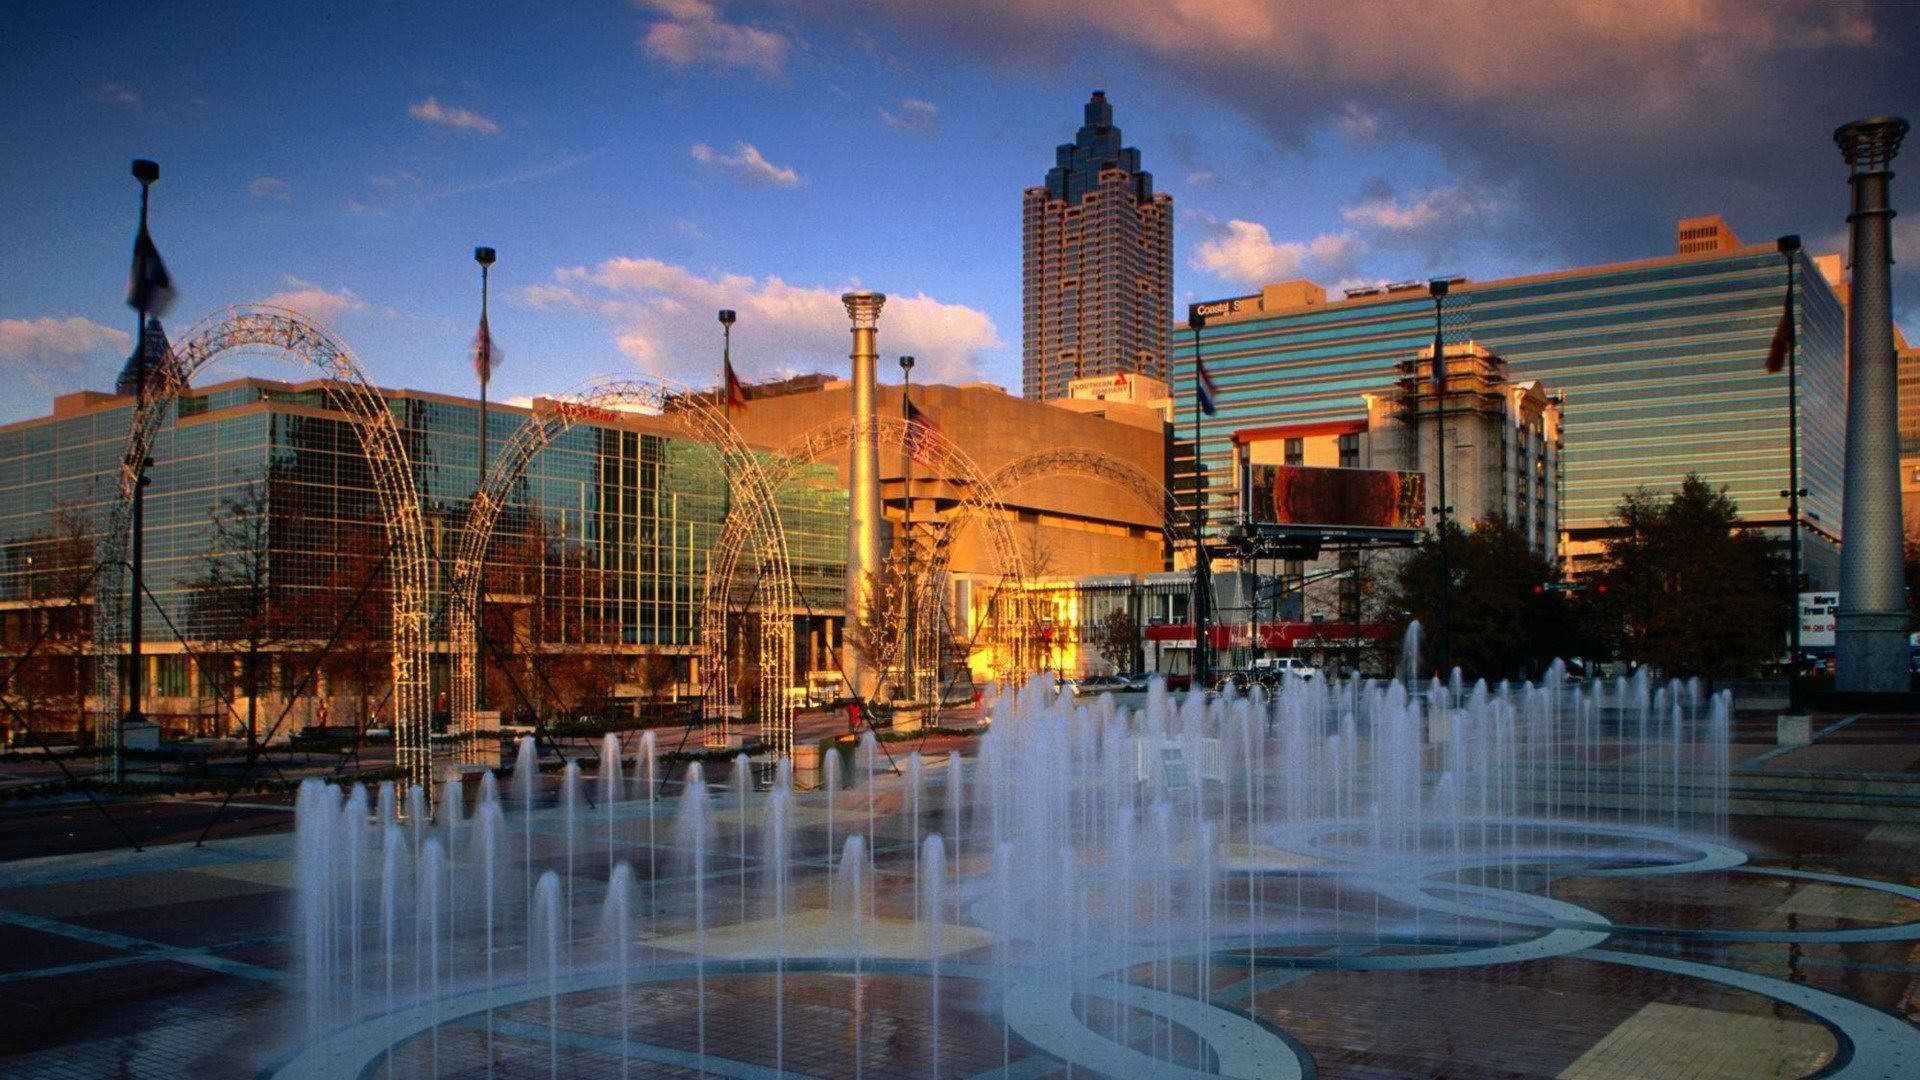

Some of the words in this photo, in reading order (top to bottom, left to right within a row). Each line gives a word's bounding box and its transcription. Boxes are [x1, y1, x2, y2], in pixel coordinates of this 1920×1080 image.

[1197, 302, 1229, 316] Coastal
[1075, 380, 1113, 391] SOUTHERN
[1091, 386, 1127, 396] COMPANY
